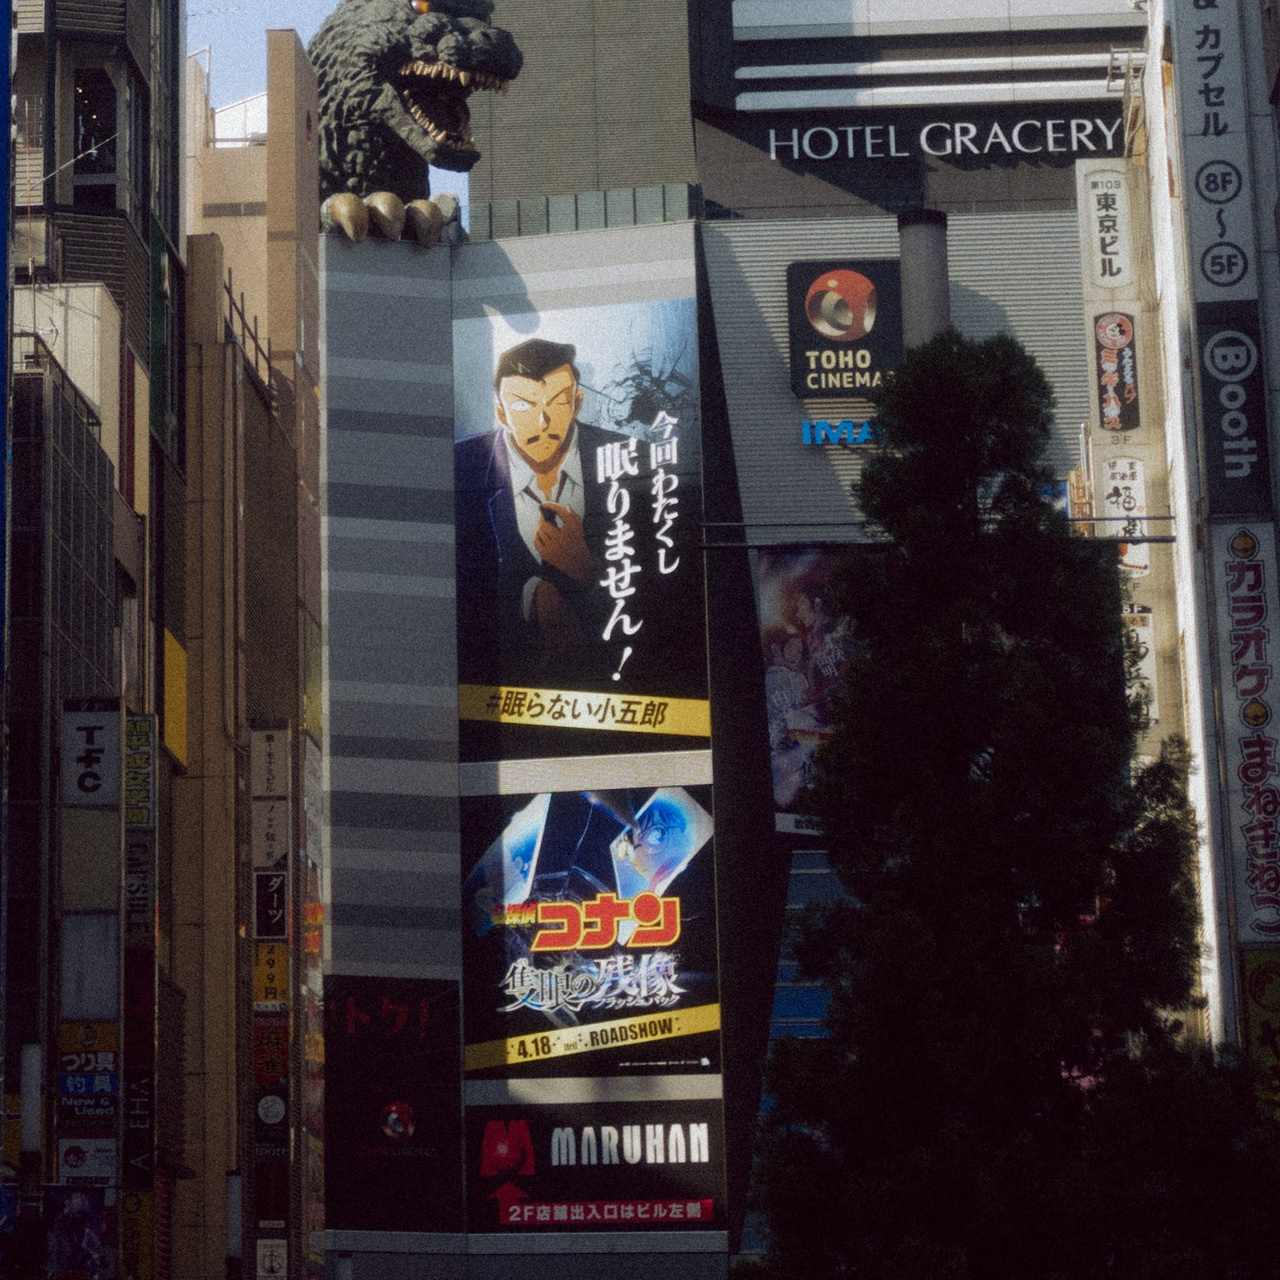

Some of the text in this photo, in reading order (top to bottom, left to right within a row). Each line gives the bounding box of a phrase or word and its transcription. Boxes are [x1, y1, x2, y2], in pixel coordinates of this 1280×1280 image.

[769, 117, 1124, 160] HOTEL GRACERY
[1096, 192, 1122, 278] 東京ビル
[805, 347, 872, 370] TOHO
[1204, 330, 1260, 479] Booth
[649, 410, 683, 576] 今回わたくし
[596, 436, 646, 683] 眠りません!
[1227, 561, 1269, 696] カラオケ
[486, 689, 669, 728] #眠らない小五郎
[496, 954, 688, 1013] 隻眼の残像
[517, 1035, 552, 1059] 4.18
[588, 1016, 674, 1049] ROADSHOW
[549, 1121, 711, 1168] MARUHAN
